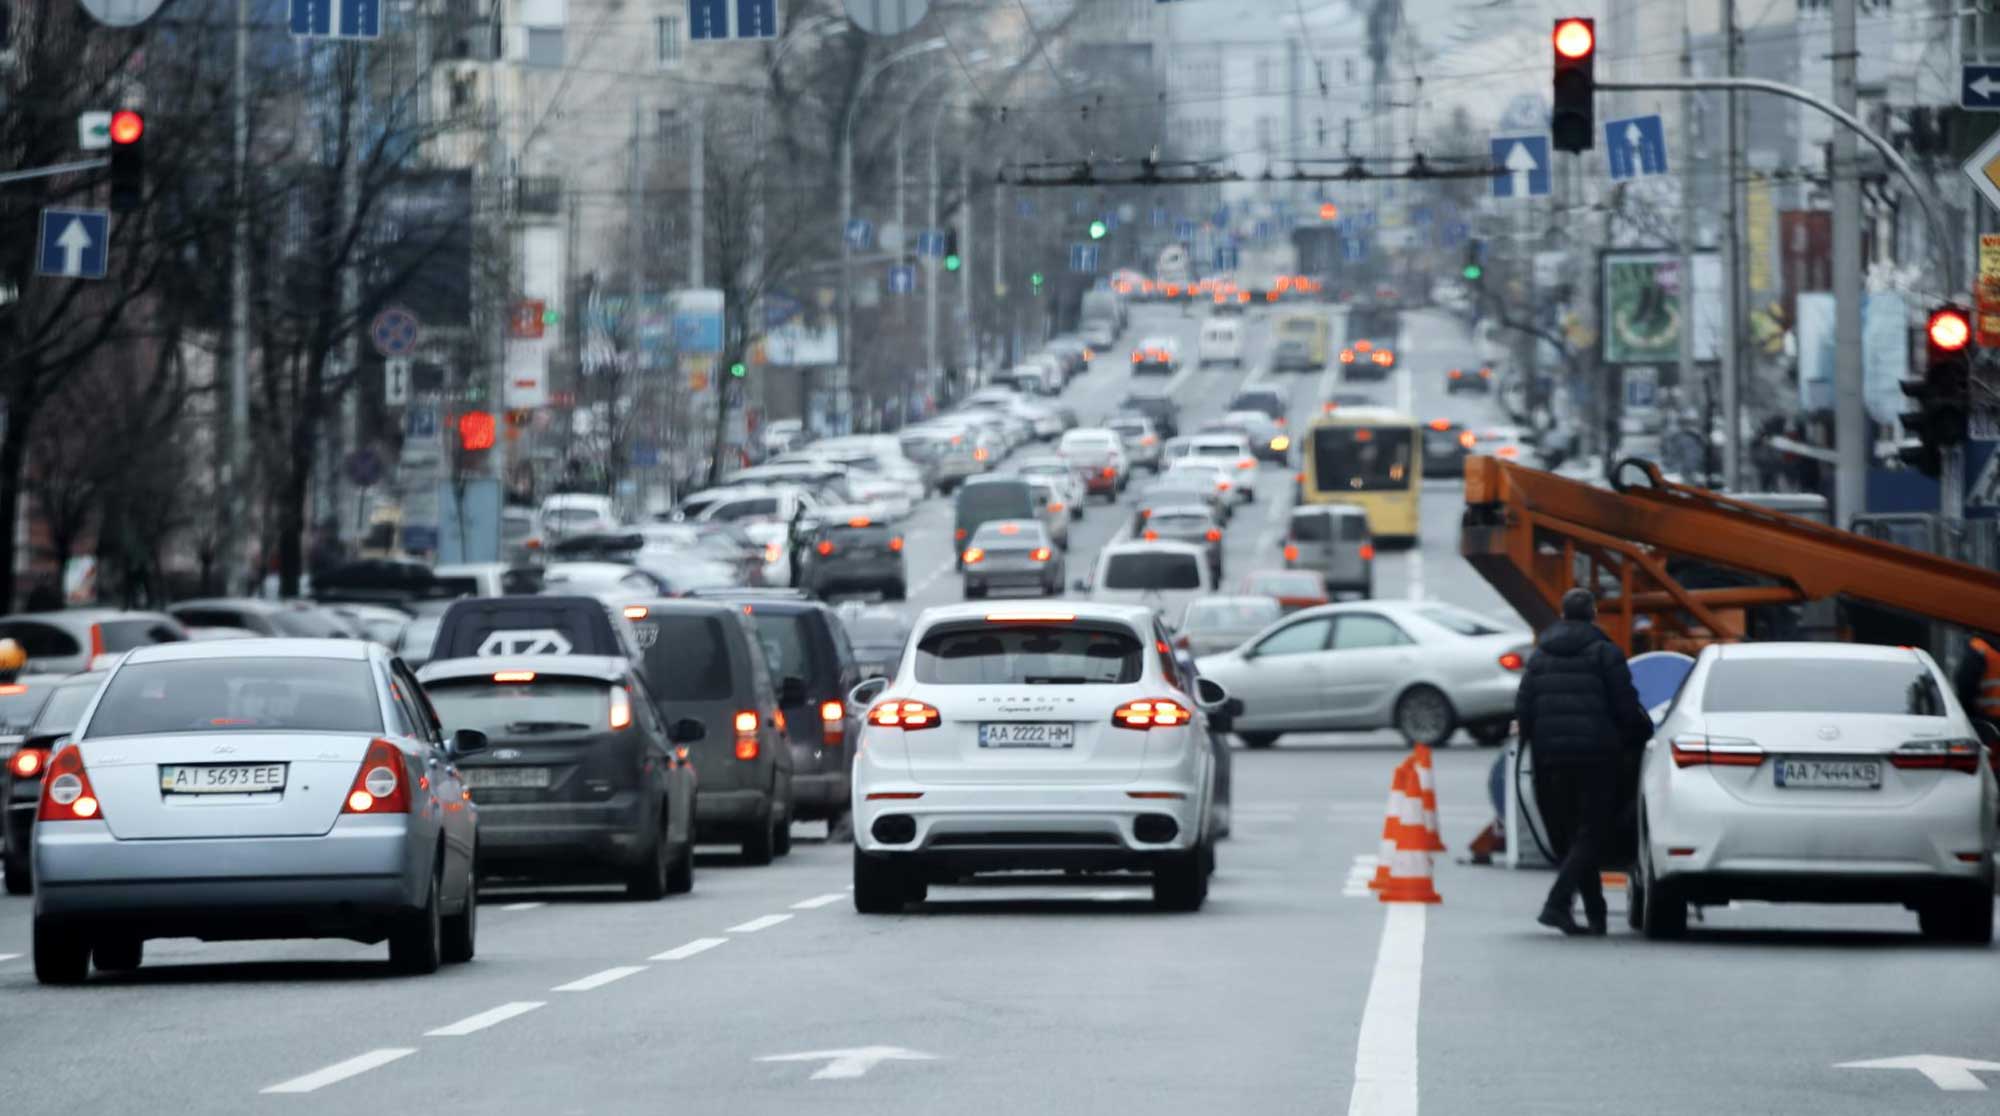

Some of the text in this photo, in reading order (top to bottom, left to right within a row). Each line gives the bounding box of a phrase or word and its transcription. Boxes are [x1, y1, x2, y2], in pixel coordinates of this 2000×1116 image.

[989, 726, 1070, 741] AA 2222 HM
[176, 767, 280, 785] AI 5693 EE
[1785, 763, 1808, 779] AA
